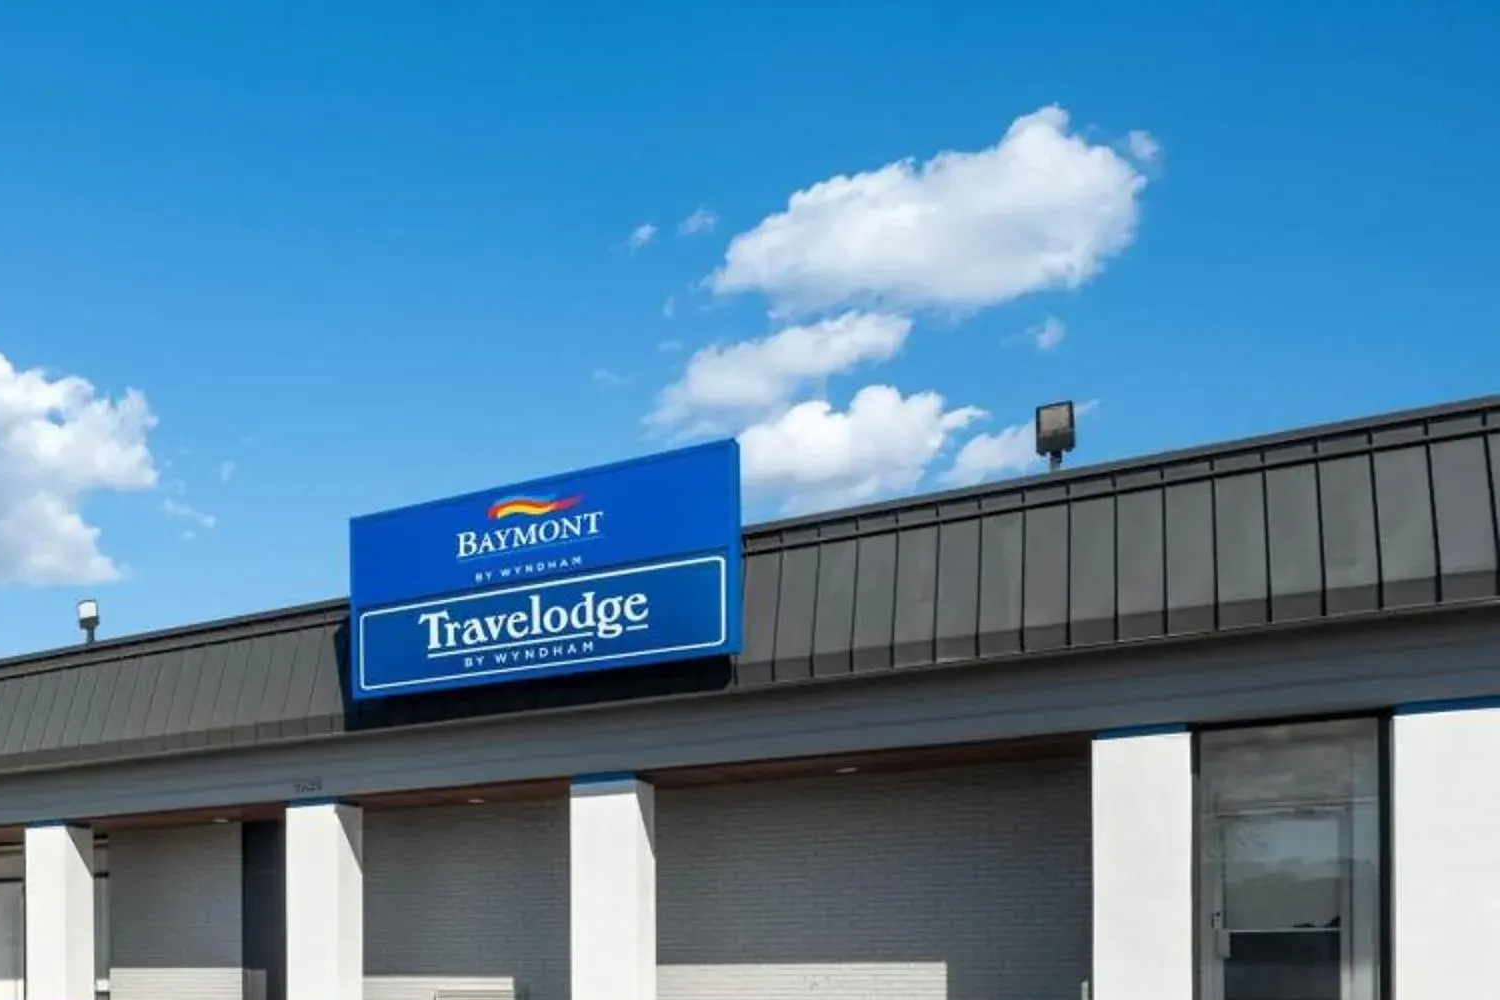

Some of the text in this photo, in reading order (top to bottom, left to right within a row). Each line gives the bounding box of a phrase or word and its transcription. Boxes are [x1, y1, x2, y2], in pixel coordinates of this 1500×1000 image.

[456, 511, 604, 558] BAYMONT
[475, 555, 584, 583] BY WYNDHAM
[418, 591, 650, 650] Travelodge
[463, 641, 595, 668] BY WYNDHAM
